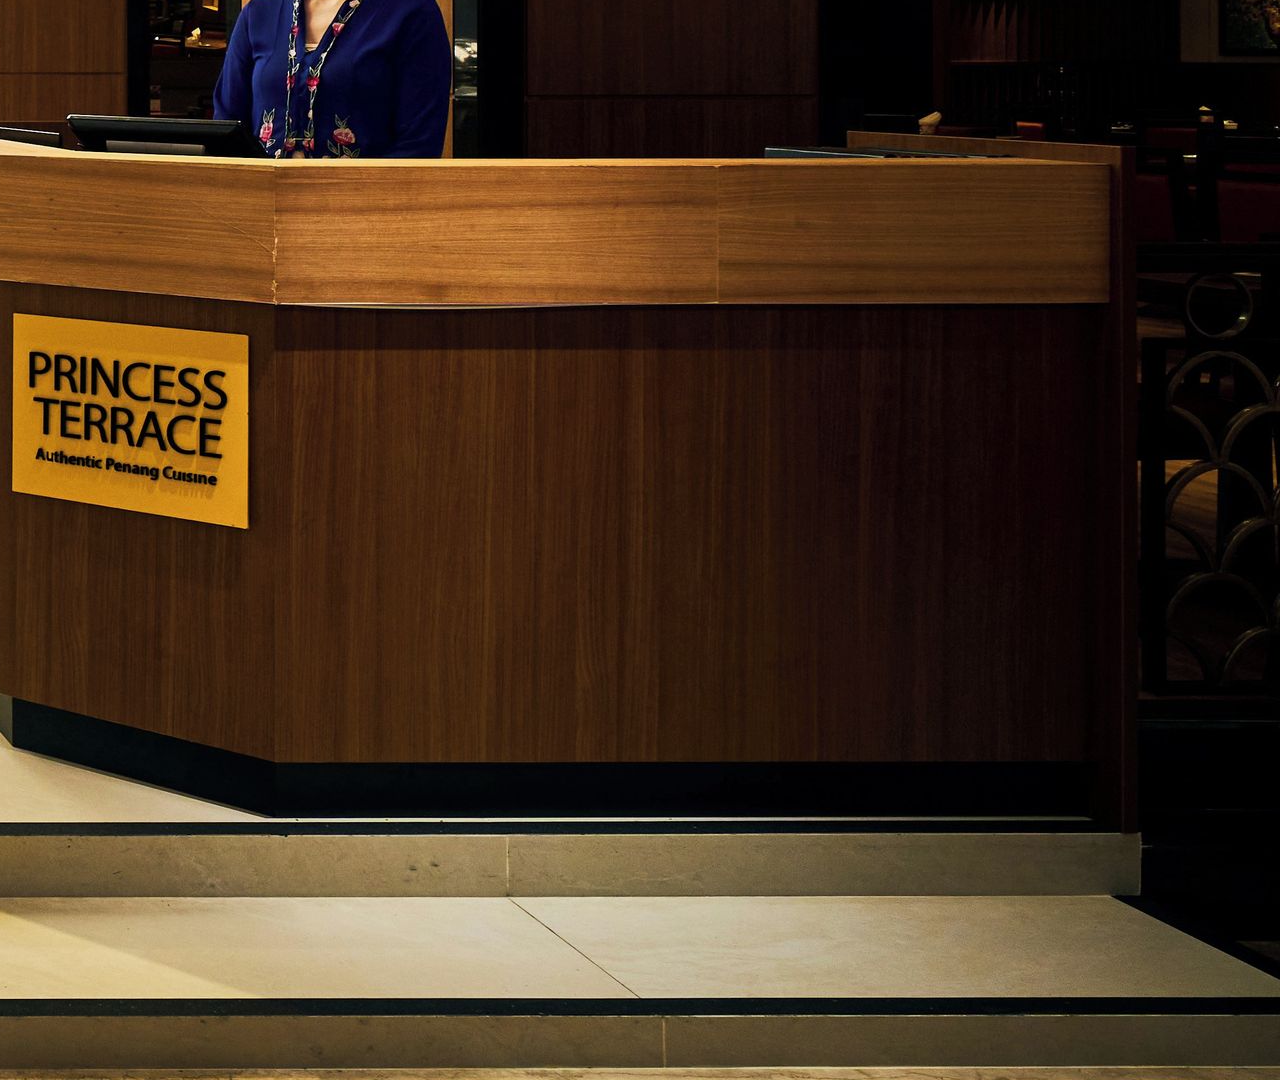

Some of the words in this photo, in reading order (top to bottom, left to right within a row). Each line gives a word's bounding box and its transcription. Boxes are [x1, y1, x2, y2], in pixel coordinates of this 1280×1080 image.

[28, 351, 228, 411] PRINCESS
[33, 396, 223, 459] TERRACE
[35, 447, 103, 470] Authentic
[105, 458, 160, 481] Penang
[162, 466, 218, 486] Cuisine
